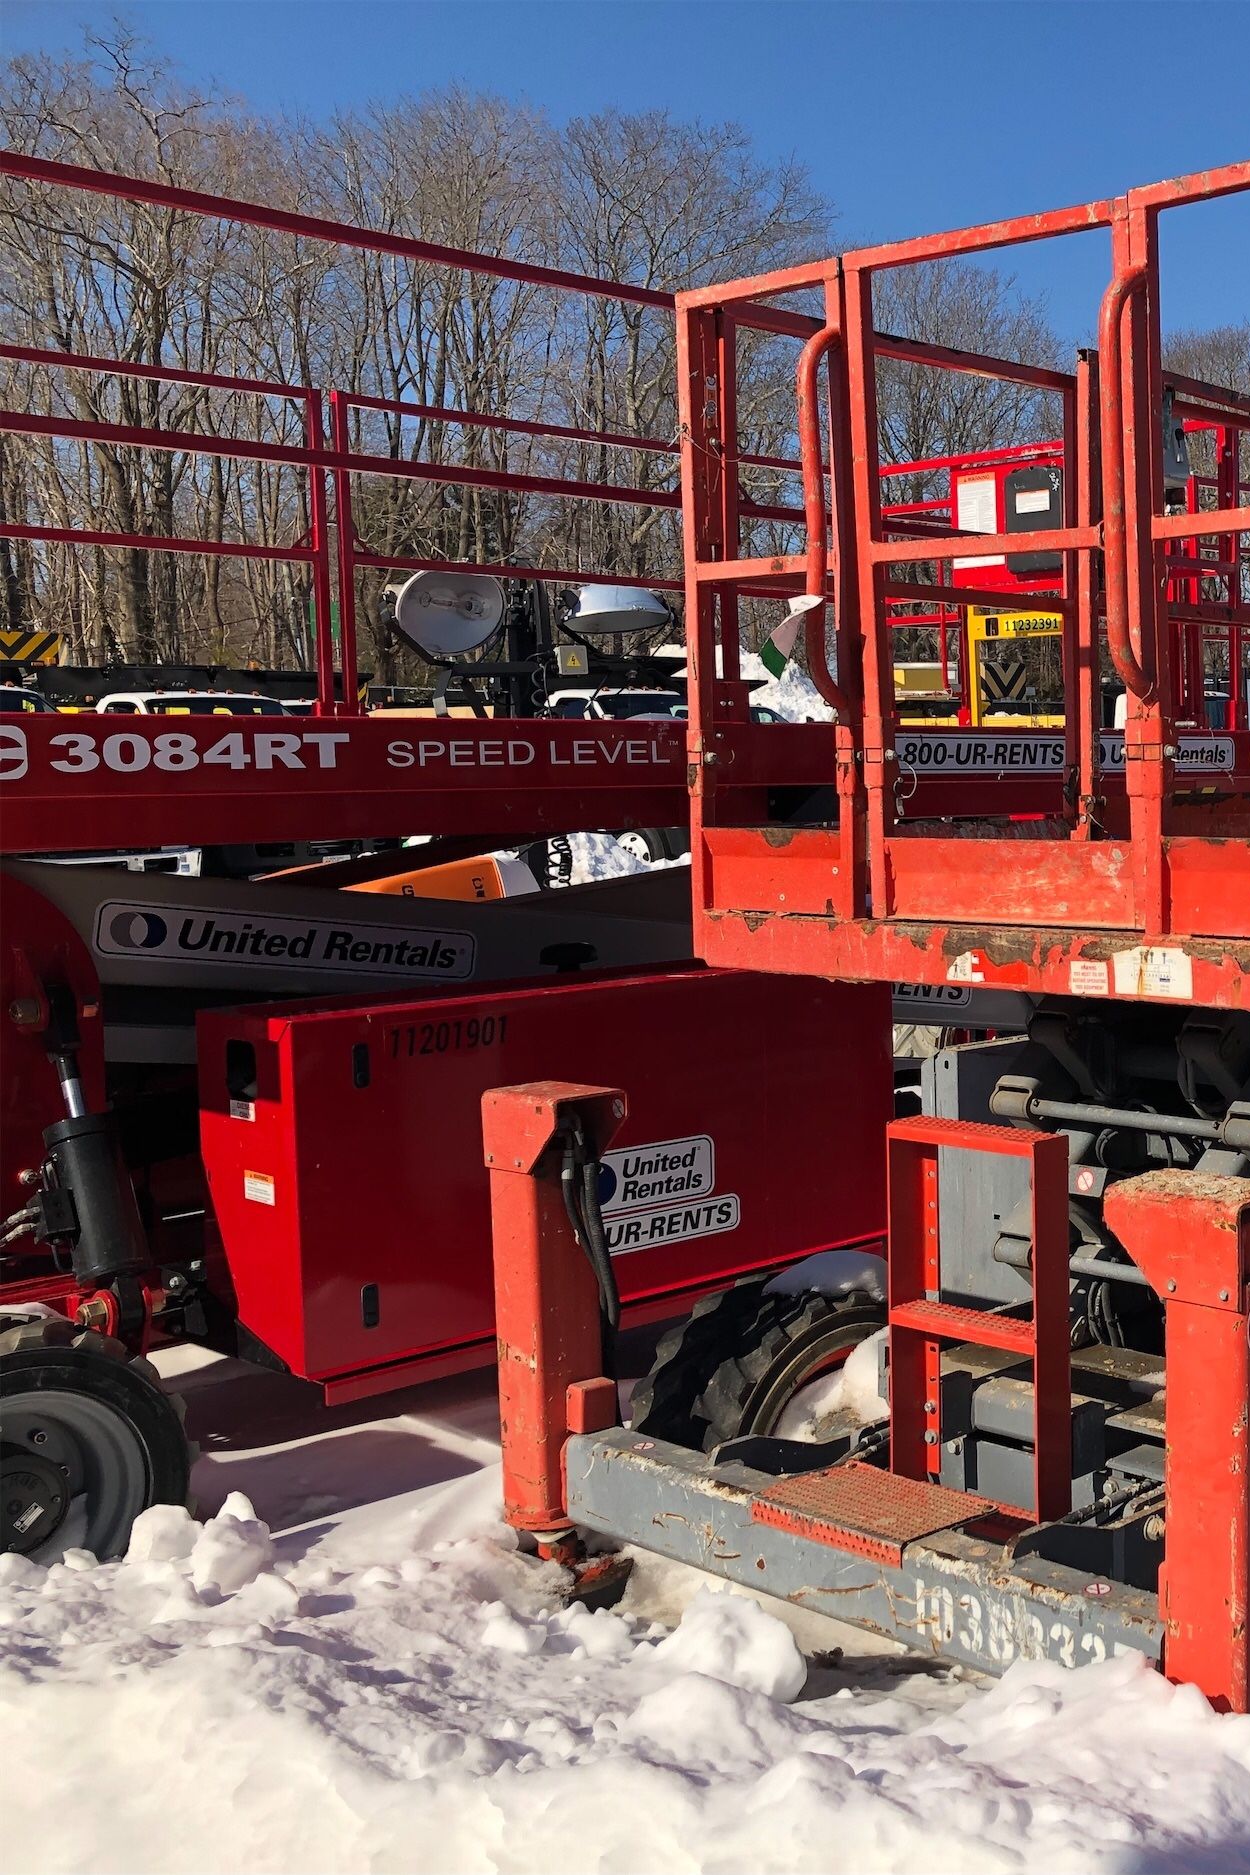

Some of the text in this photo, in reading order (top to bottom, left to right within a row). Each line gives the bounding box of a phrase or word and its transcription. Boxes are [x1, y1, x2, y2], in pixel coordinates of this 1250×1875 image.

[1005, 617, 1059, 632] 11232391
[49, 732, 350, 773] 3084RT
[386, 740, 535, 767] SPEED
[897, 742, 1064, 766] -800-UR-RENTS
[178, 919, 457, 969] United Rentals
[390, 1015, 507, 1058] 11201901
[622, 1146, 697, 1179] United
[621, 1169, 704, 1202] Rentals
[607, 1202, 732, 1248] UR-RENTS
